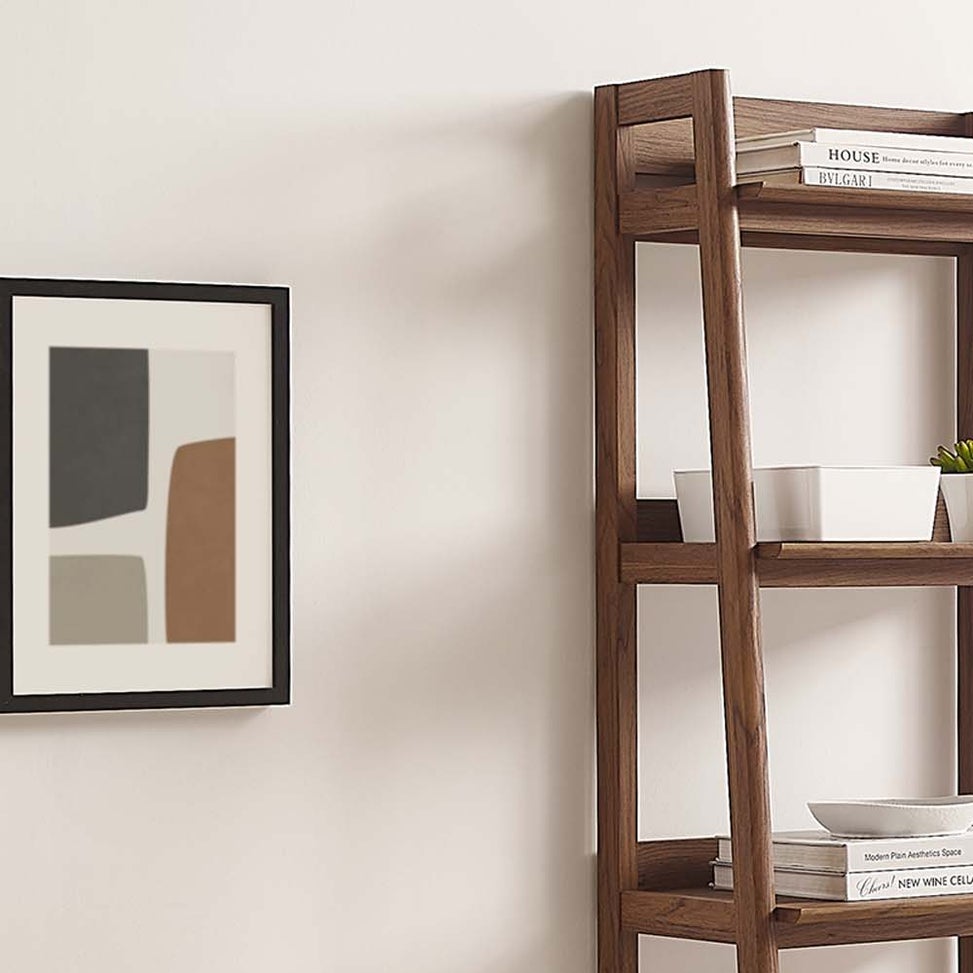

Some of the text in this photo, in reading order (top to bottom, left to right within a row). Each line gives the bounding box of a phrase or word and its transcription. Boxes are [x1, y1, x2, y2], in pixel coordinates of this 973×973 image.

[829, 149, 880, 164] HOUSE
[864, 848, 962, 862] Modern Plain Aesthetics Space
[898, 878, 921, 889] NEW
[923, 876, 948, 887] WINE
